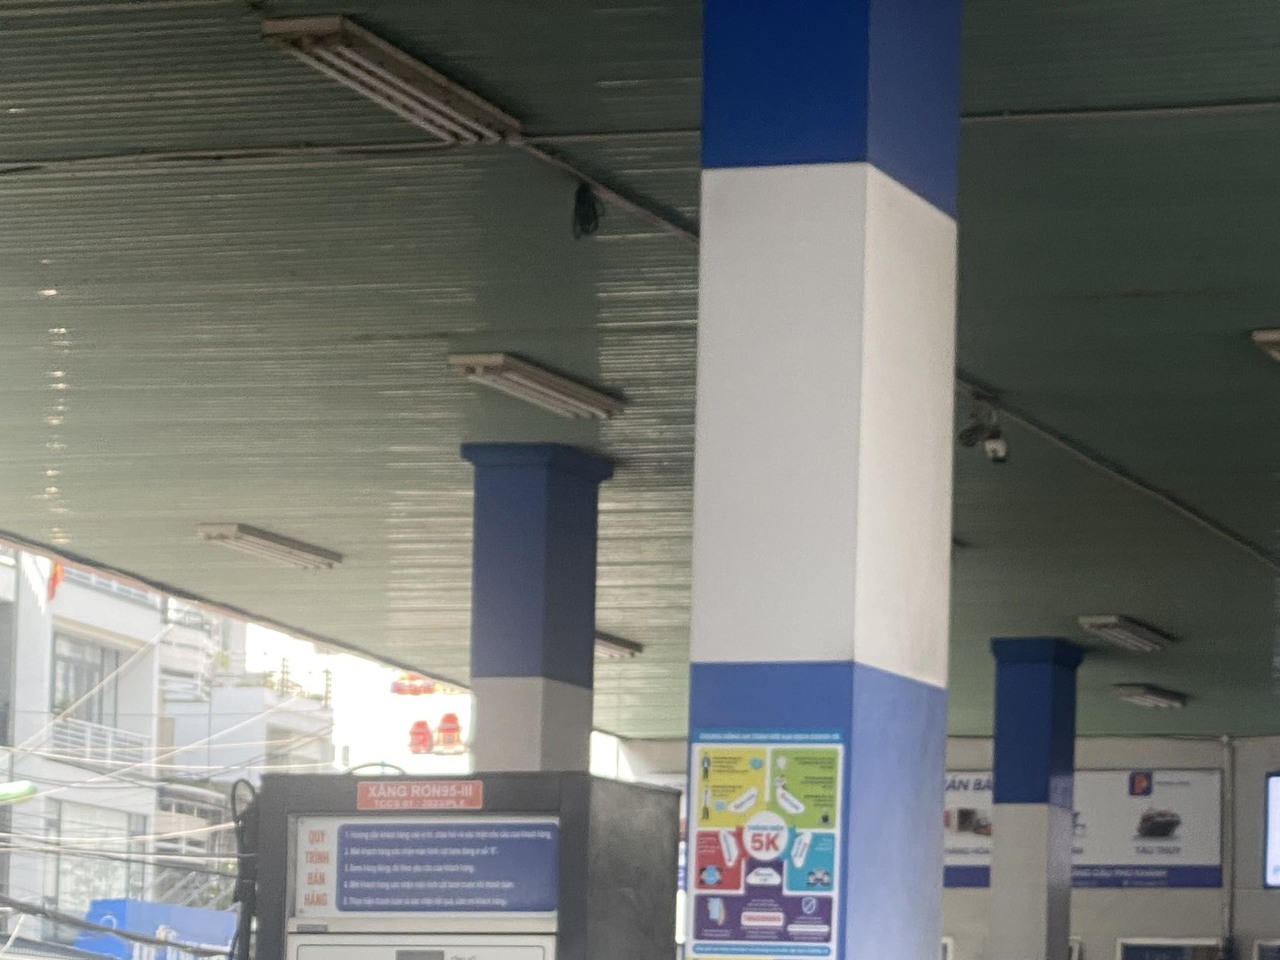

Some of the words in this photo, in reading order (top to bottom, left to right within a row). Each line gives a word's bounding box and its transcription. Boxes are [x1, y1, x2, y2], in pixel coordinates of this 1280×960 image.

[368, 782, 407, 798] XĂNG
[411, 783, 473, 798] RON95-III
[750, 832, 779, 852] 5K
